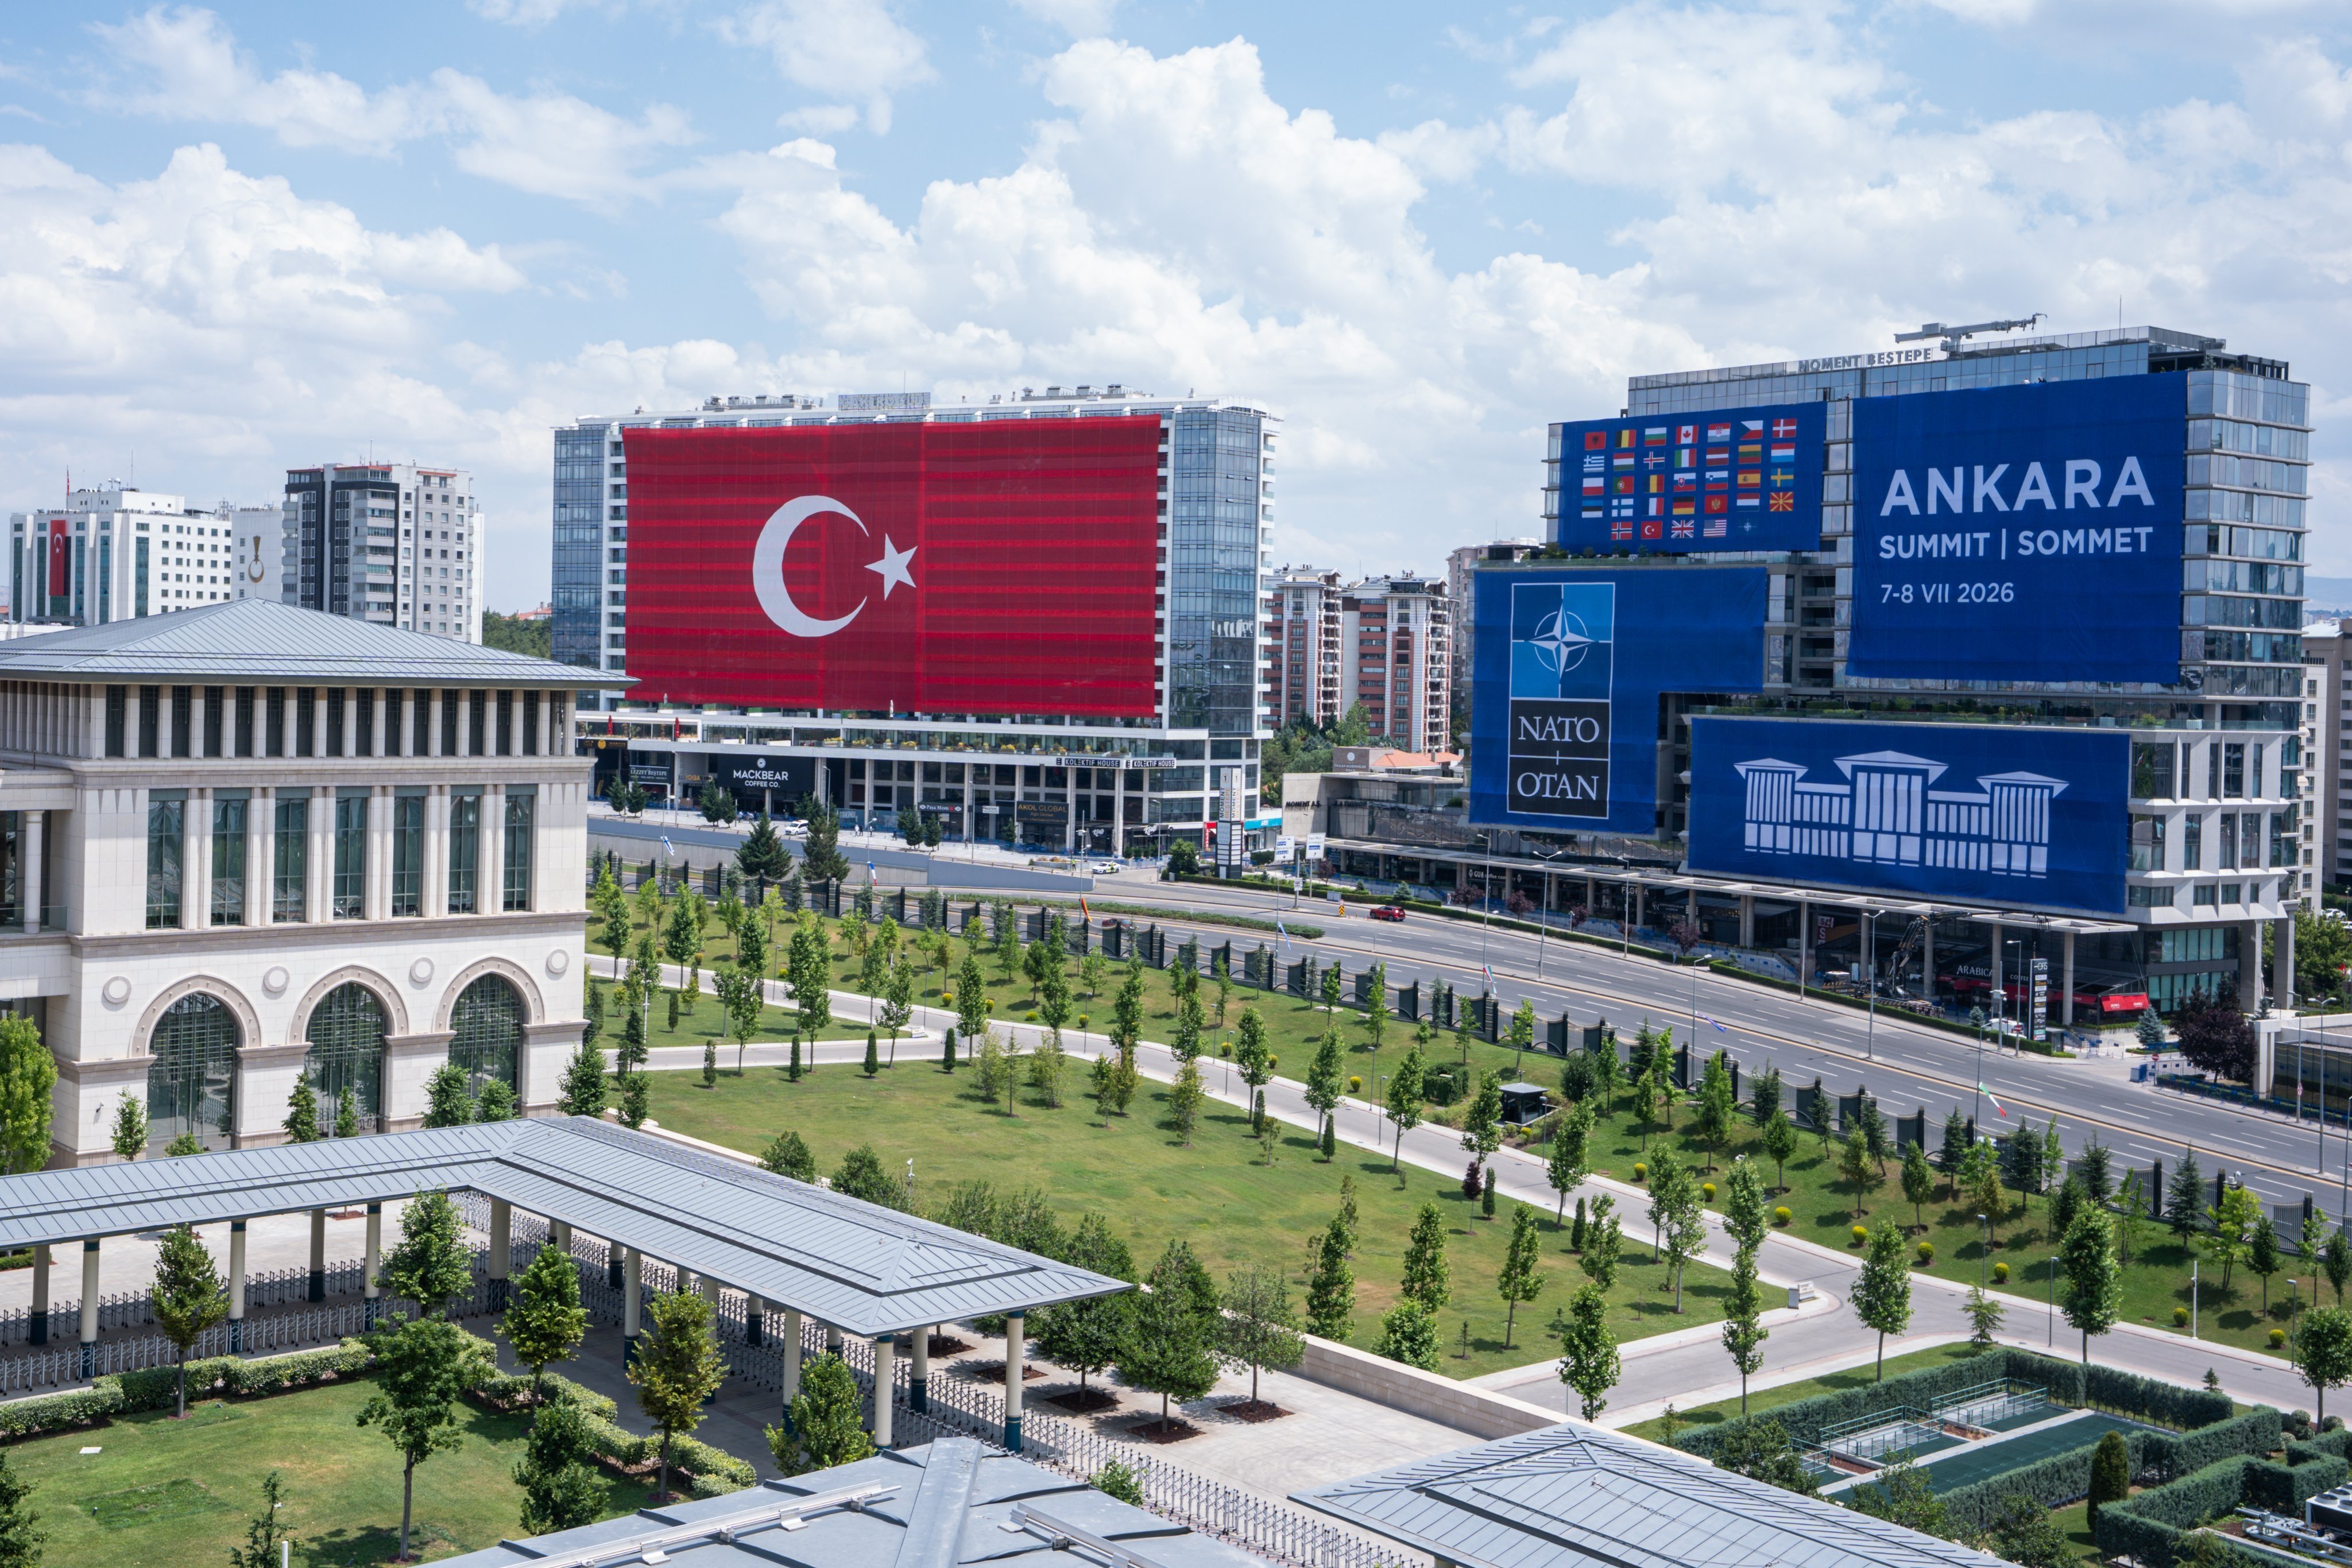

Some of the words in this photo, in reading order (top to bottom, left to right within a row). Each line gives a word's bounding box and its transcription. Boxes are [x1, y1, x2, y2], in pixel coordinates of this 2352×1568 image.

[1798, 355, 1860, 372] MOMENT
[1867, 348, 1931, 365] BEŞTEPE
[1880, 456, 2154, 516] ANKARA
[1879, 532, 1990, 559] SUMMIT
[2018, 527, 2153, 556] SOMMET
[1881, 584, 1913, 603] 7-8
[1921, 583, 1949, 603] VII
[1958, 582, 2014, 603] 2026
[1518, 716, 1600, 743] NATO
[733, 769, 788, 780] MACKBEAR
[1517, 772, 1599, 800] OTAN
[1038, 805, 1067, 813] GLOBAL
[1474, 870, 1484, 878] GUA
